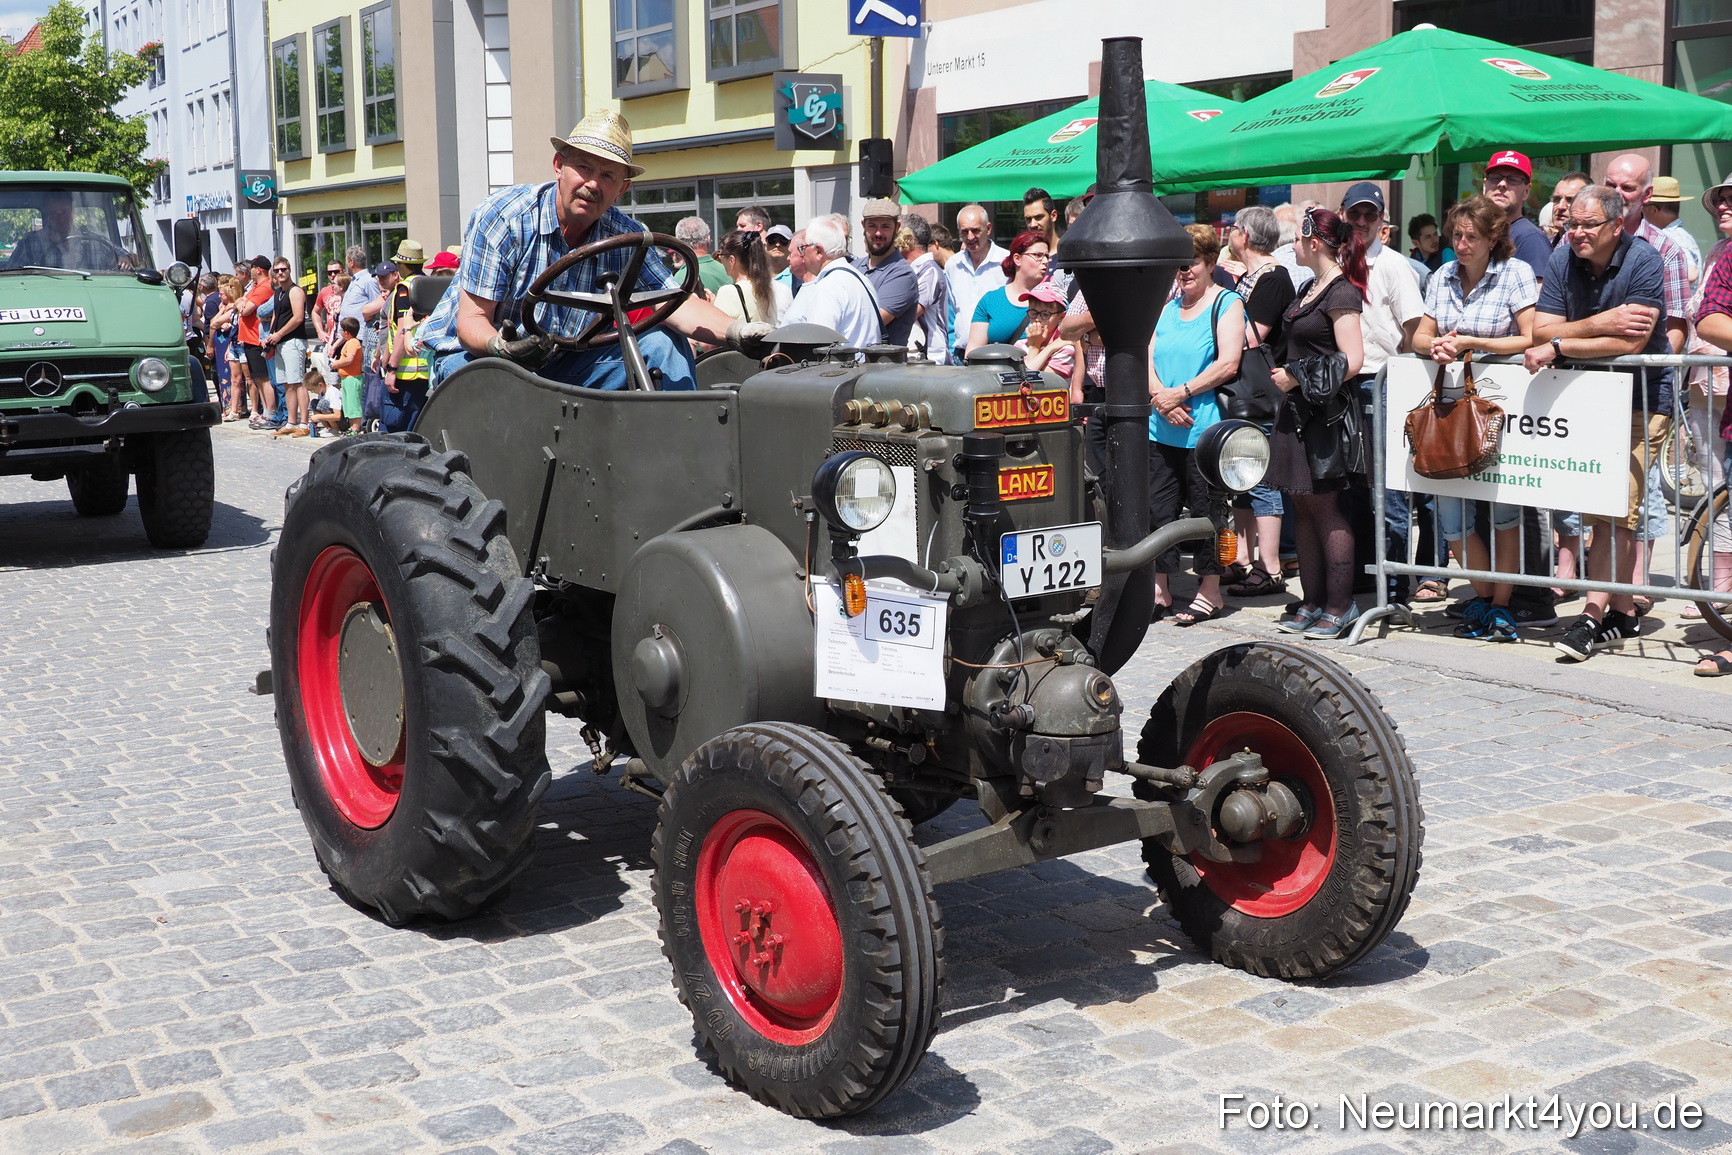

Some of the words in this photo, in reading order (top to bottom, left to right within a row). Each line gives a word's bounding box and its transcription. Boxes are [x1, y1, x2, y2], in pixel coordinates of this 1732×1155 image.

[927, 61, 953, 76] Unterer
[954, 56, 975, 71] Markt
[977, 52, 986, 68] 15
[1508, 82, 1606, 92] Neumarkter
[1508, 90, 1644, 103] Lammsbräu
[1229, 105, 1364, 133] Lammsbräu
[1265, 97, 1364, 117] Neumarkter
[976, 153, 1080, 169] Lammsbräu
[1008, 145, 1082, 156] Neumarkter
[30, 309, 41, 320] U
[44, 308, 83, 319] 1970
[1500, 413, 1570, 439] ress
[998, 470, 1049, 495] LANZ
[1032, 534, 1046, 561] R
[1020, 566, 1034, 593] Y
[1043, 559, 1086, 590] 122
[879, 608, 921, 638] 635
[1318, 783, 1353, 917] TRELLEBORG
[684, 972, 713, 1003] 27
[748, 1034, 839, 1082] TRELLEBORG
